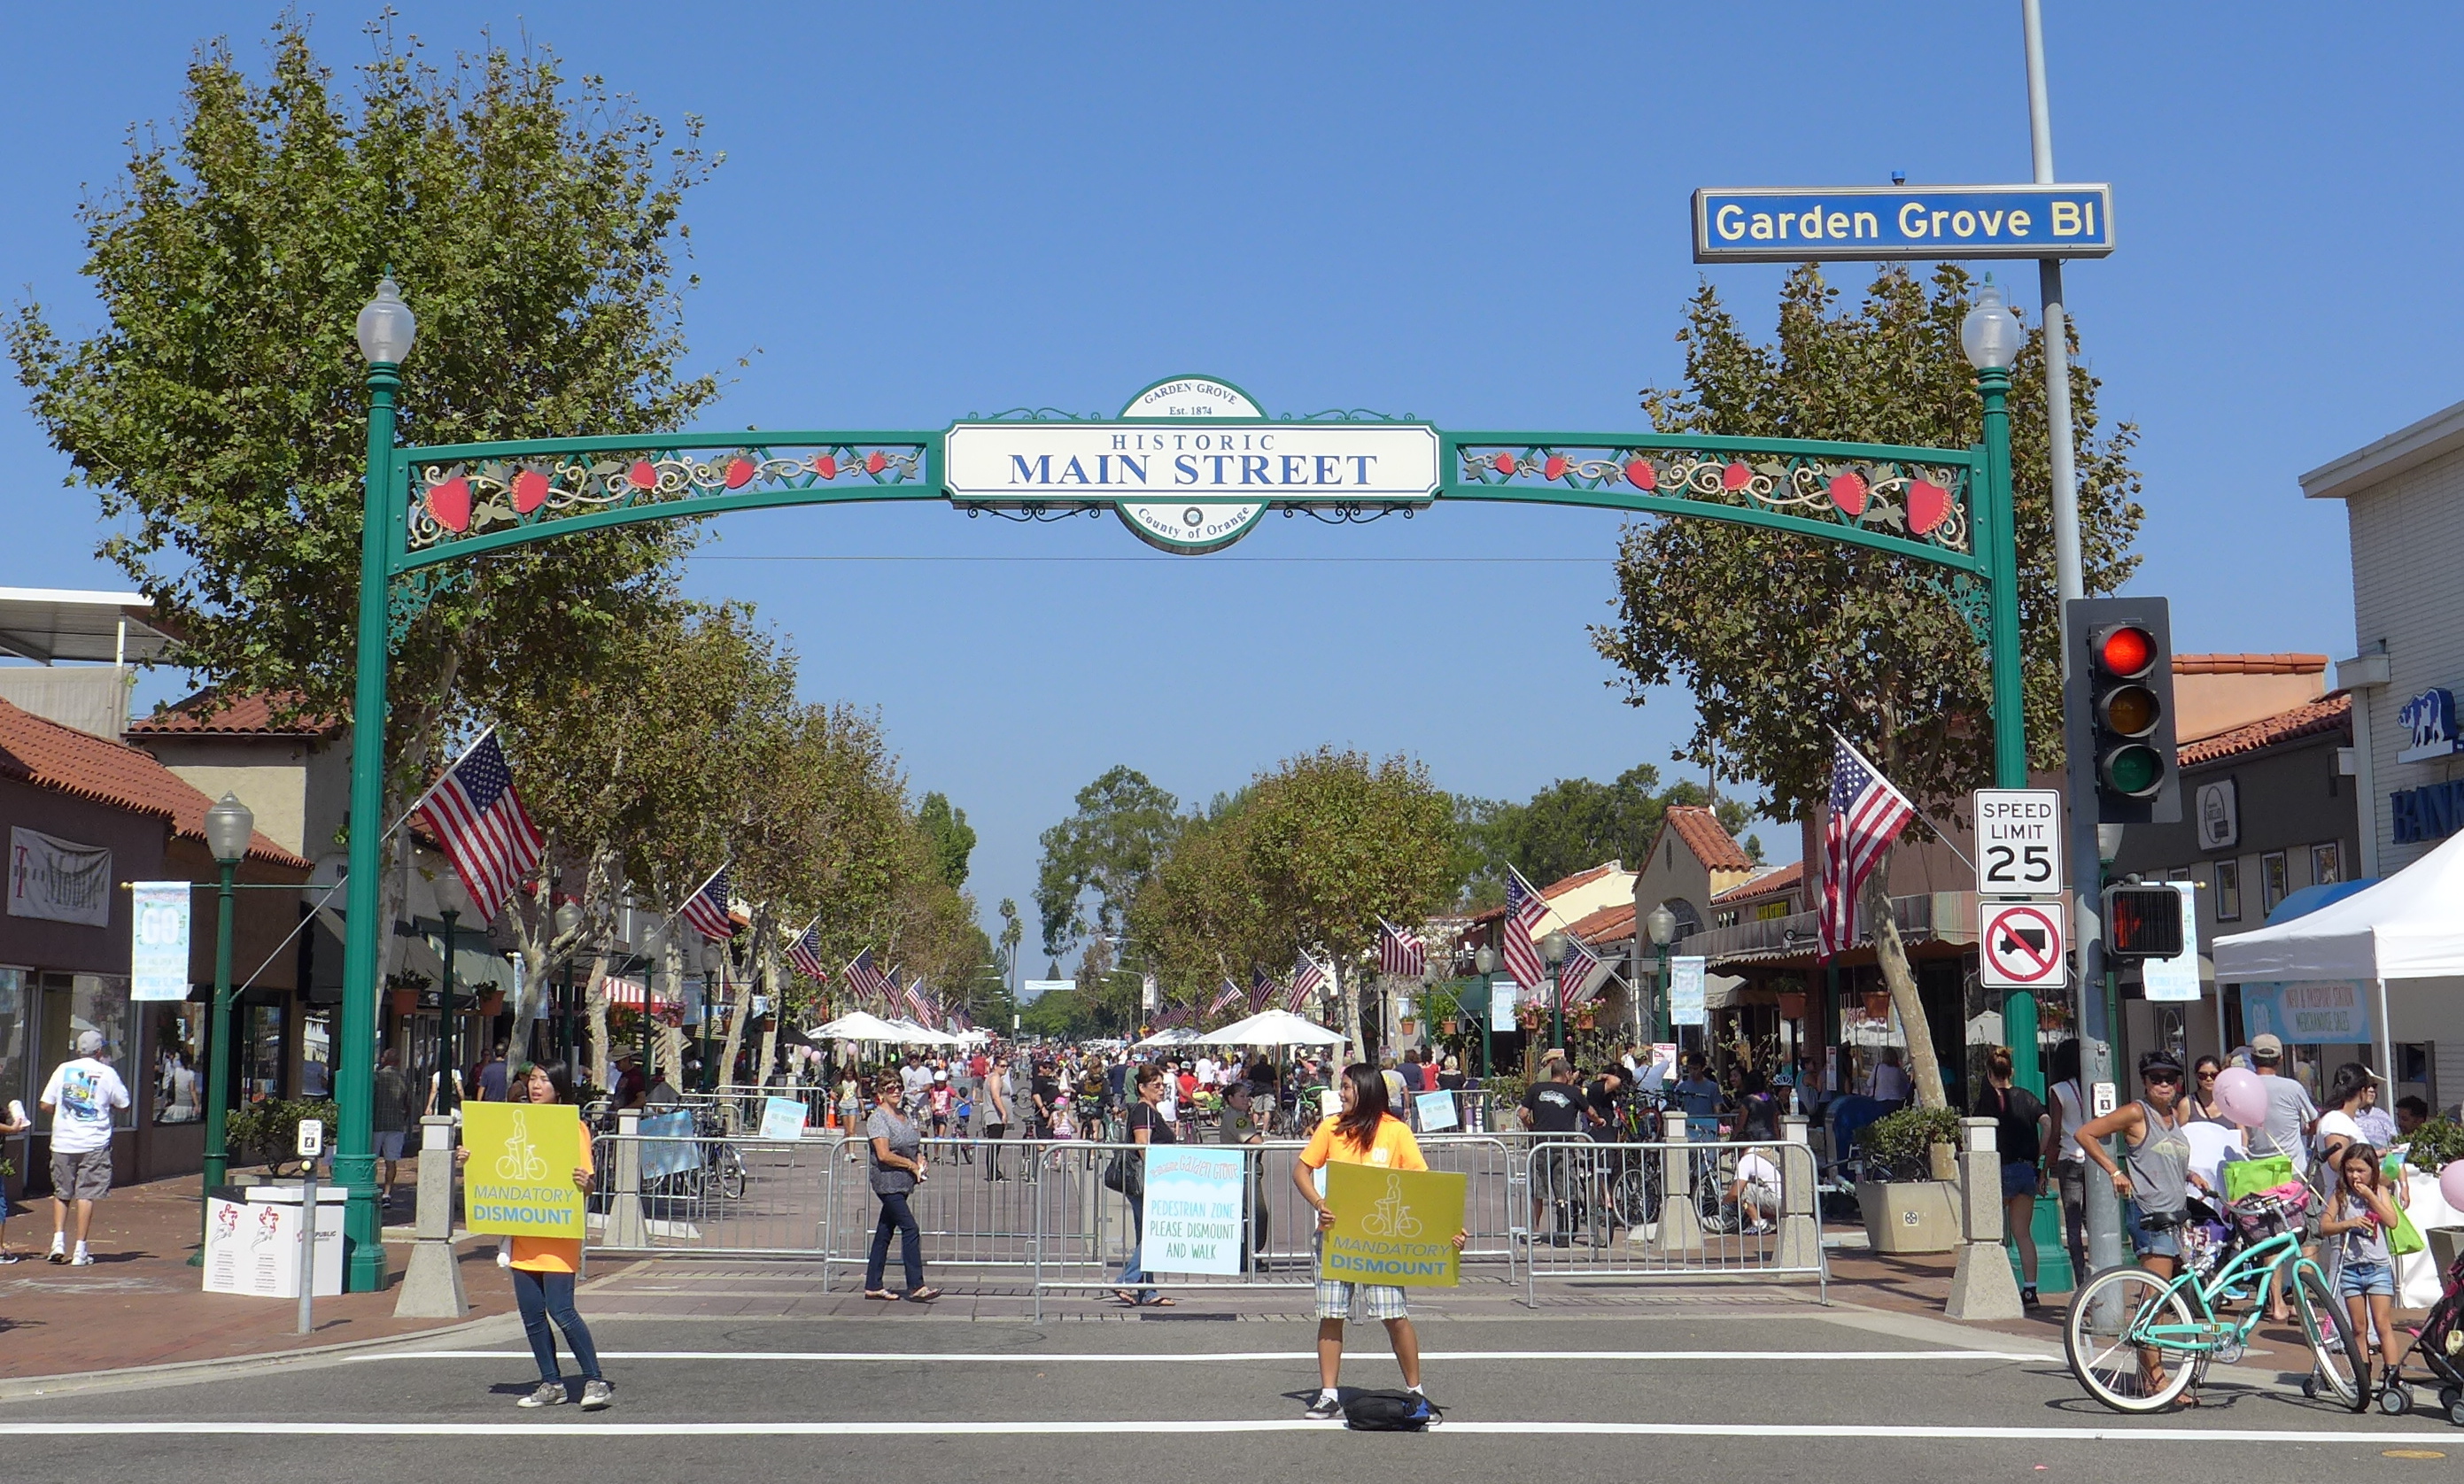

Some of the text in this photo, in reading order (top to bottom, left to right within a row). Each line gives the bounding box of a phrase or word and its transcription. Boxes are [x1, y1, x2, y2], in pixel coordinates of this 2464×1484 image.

[1716, 201, 2094, 241] Garden Grove Bl
[1144, 383, 1237, 405] GARDEN GROVE
[1169, 406, 1213, 415] Est. 1874
[1112, 434, 1275, 451] HISTORIC
[1008, 454, 1377, 485] MAIN STREET
[1138, 506, 1250, 538] County of Orange
[1983, 803, 2051, 818] SPEED
[1991, 824, 2044, 839] LIMIT
[1987, 845, 2052, 883] 25
[1180, 1155, 1211, 1179] Garden
[474, 1185, 574, 1202] MANDATORY
[474, 1205, 572, 1225] DISMOUNT
[1151, 1200, 1235, 1219] PEDESTRIAN ZONE
[1150, 1220, 1235, 1240] PLEASE DISMOUNT
[1166, 1242, 1216, 1260] AND WALK
[1333, 1236, 1452, 1256] MANDATORY
[1331, 1254, 1447, 1276] DISMOUNT
